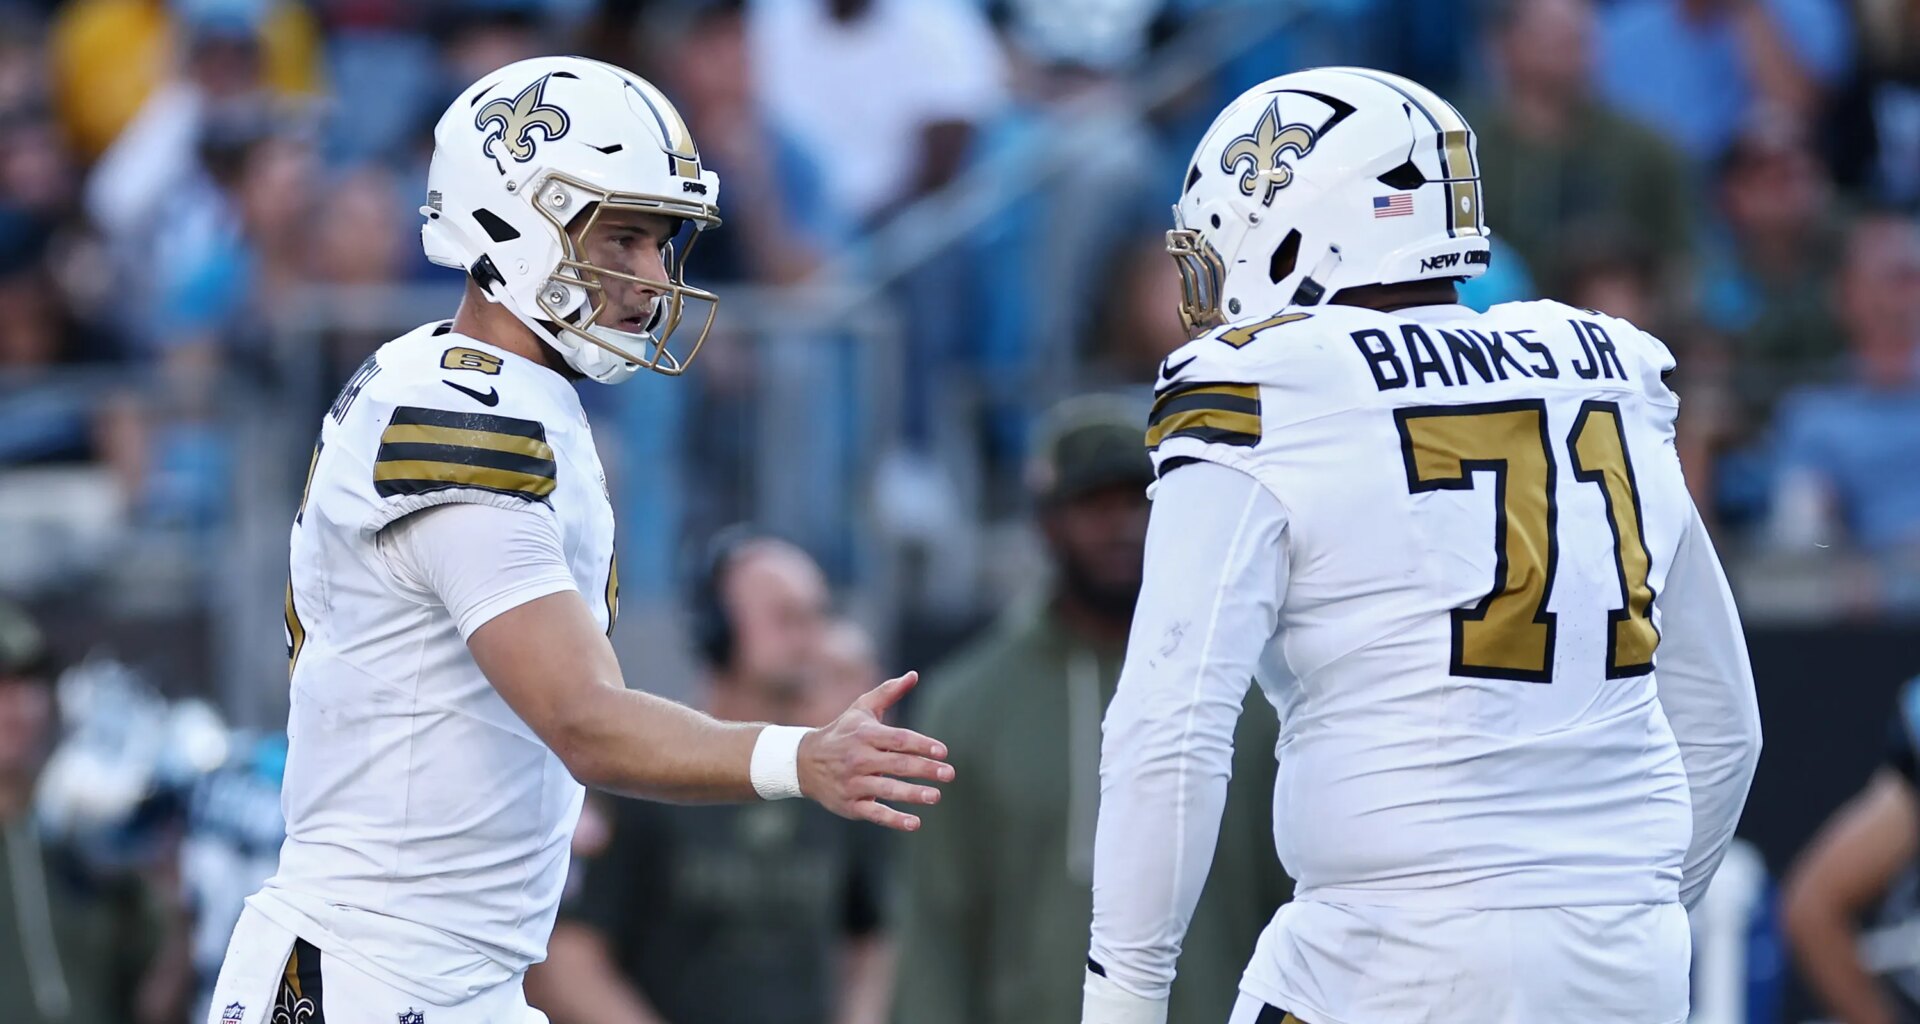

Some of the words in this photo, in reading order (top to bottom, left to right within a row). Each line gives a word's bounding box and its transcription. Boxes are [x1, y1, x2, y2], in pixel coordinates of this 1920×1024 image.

[1196, 312, 1315, 350] 1
[1350, 324, 1560, 391] BANKS
[1567, 319, 1629, 381] JR
[440, 346, 504, 375] 6
[1393, 398, 1661, 684] 71
